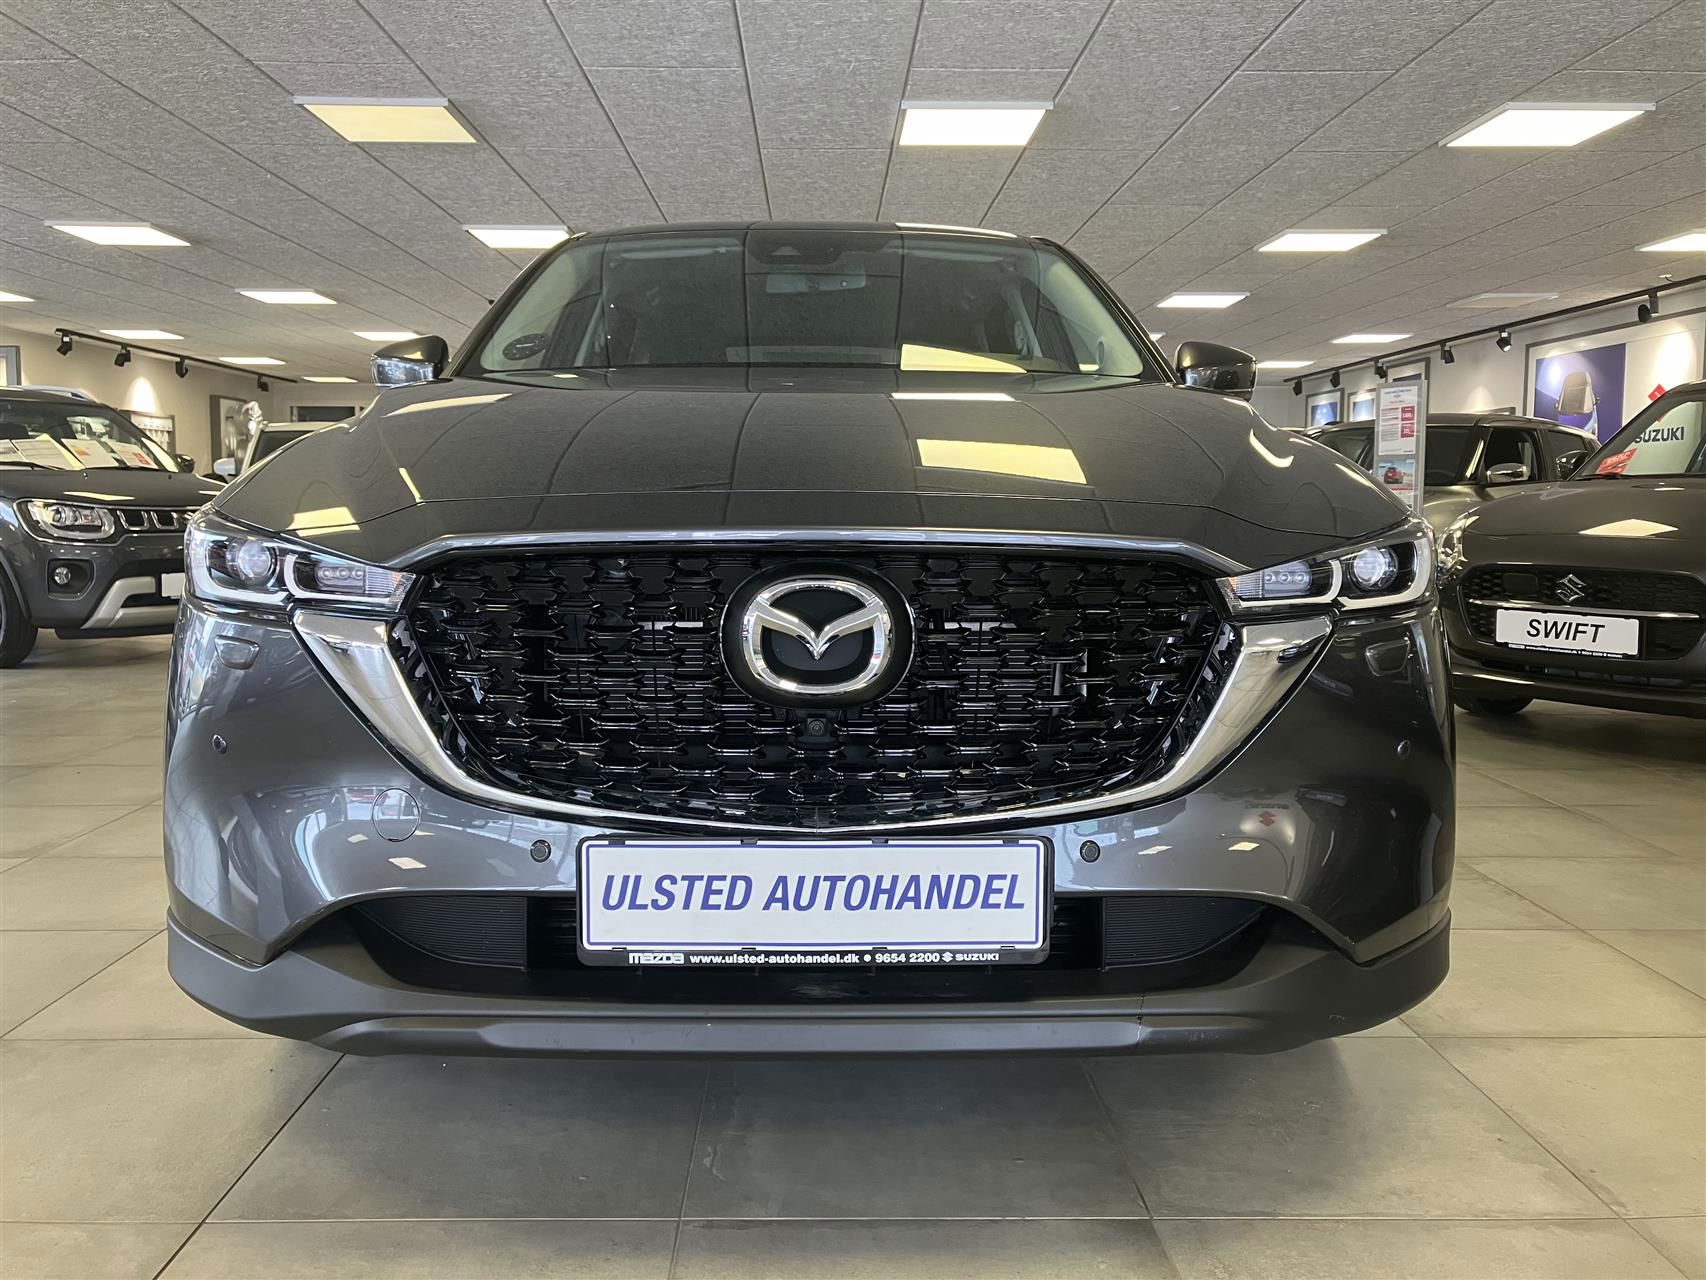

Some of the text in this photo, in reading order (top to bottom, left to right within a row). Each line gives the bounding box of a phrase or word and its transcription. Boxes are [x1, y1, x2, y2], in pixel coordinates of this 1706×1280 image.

[1526, 618, 1606, 643] SWIFT
[601, 873, 1026, 911] ULSTED AUTOHANDEL
[689, 953, 860, 964] www.ulsted-autohandel.dk
[875, 952, 906, 963] 9654
[909, 952, 940, 963] 2200
[955, 952, 999, 962] SUZUKI
